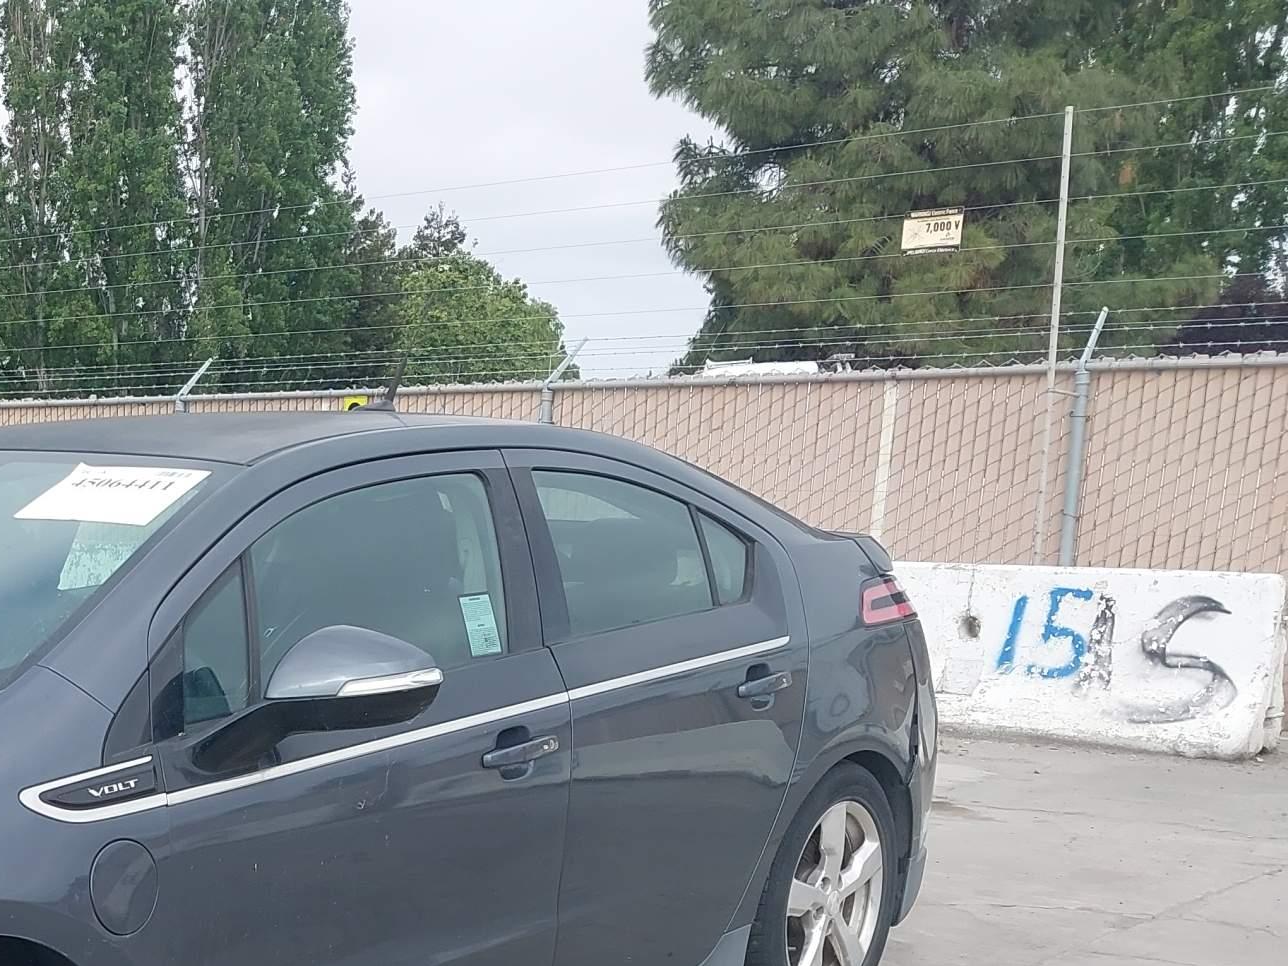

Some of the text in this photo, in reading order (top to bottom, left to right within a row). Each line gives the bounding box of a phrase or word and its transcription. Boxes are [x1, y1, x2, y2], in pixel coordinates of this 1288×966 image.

[925, 221, 952, 234] 7,000
[954, 220, 960, 230] V
[88, 778, 139, 798] VOLT
